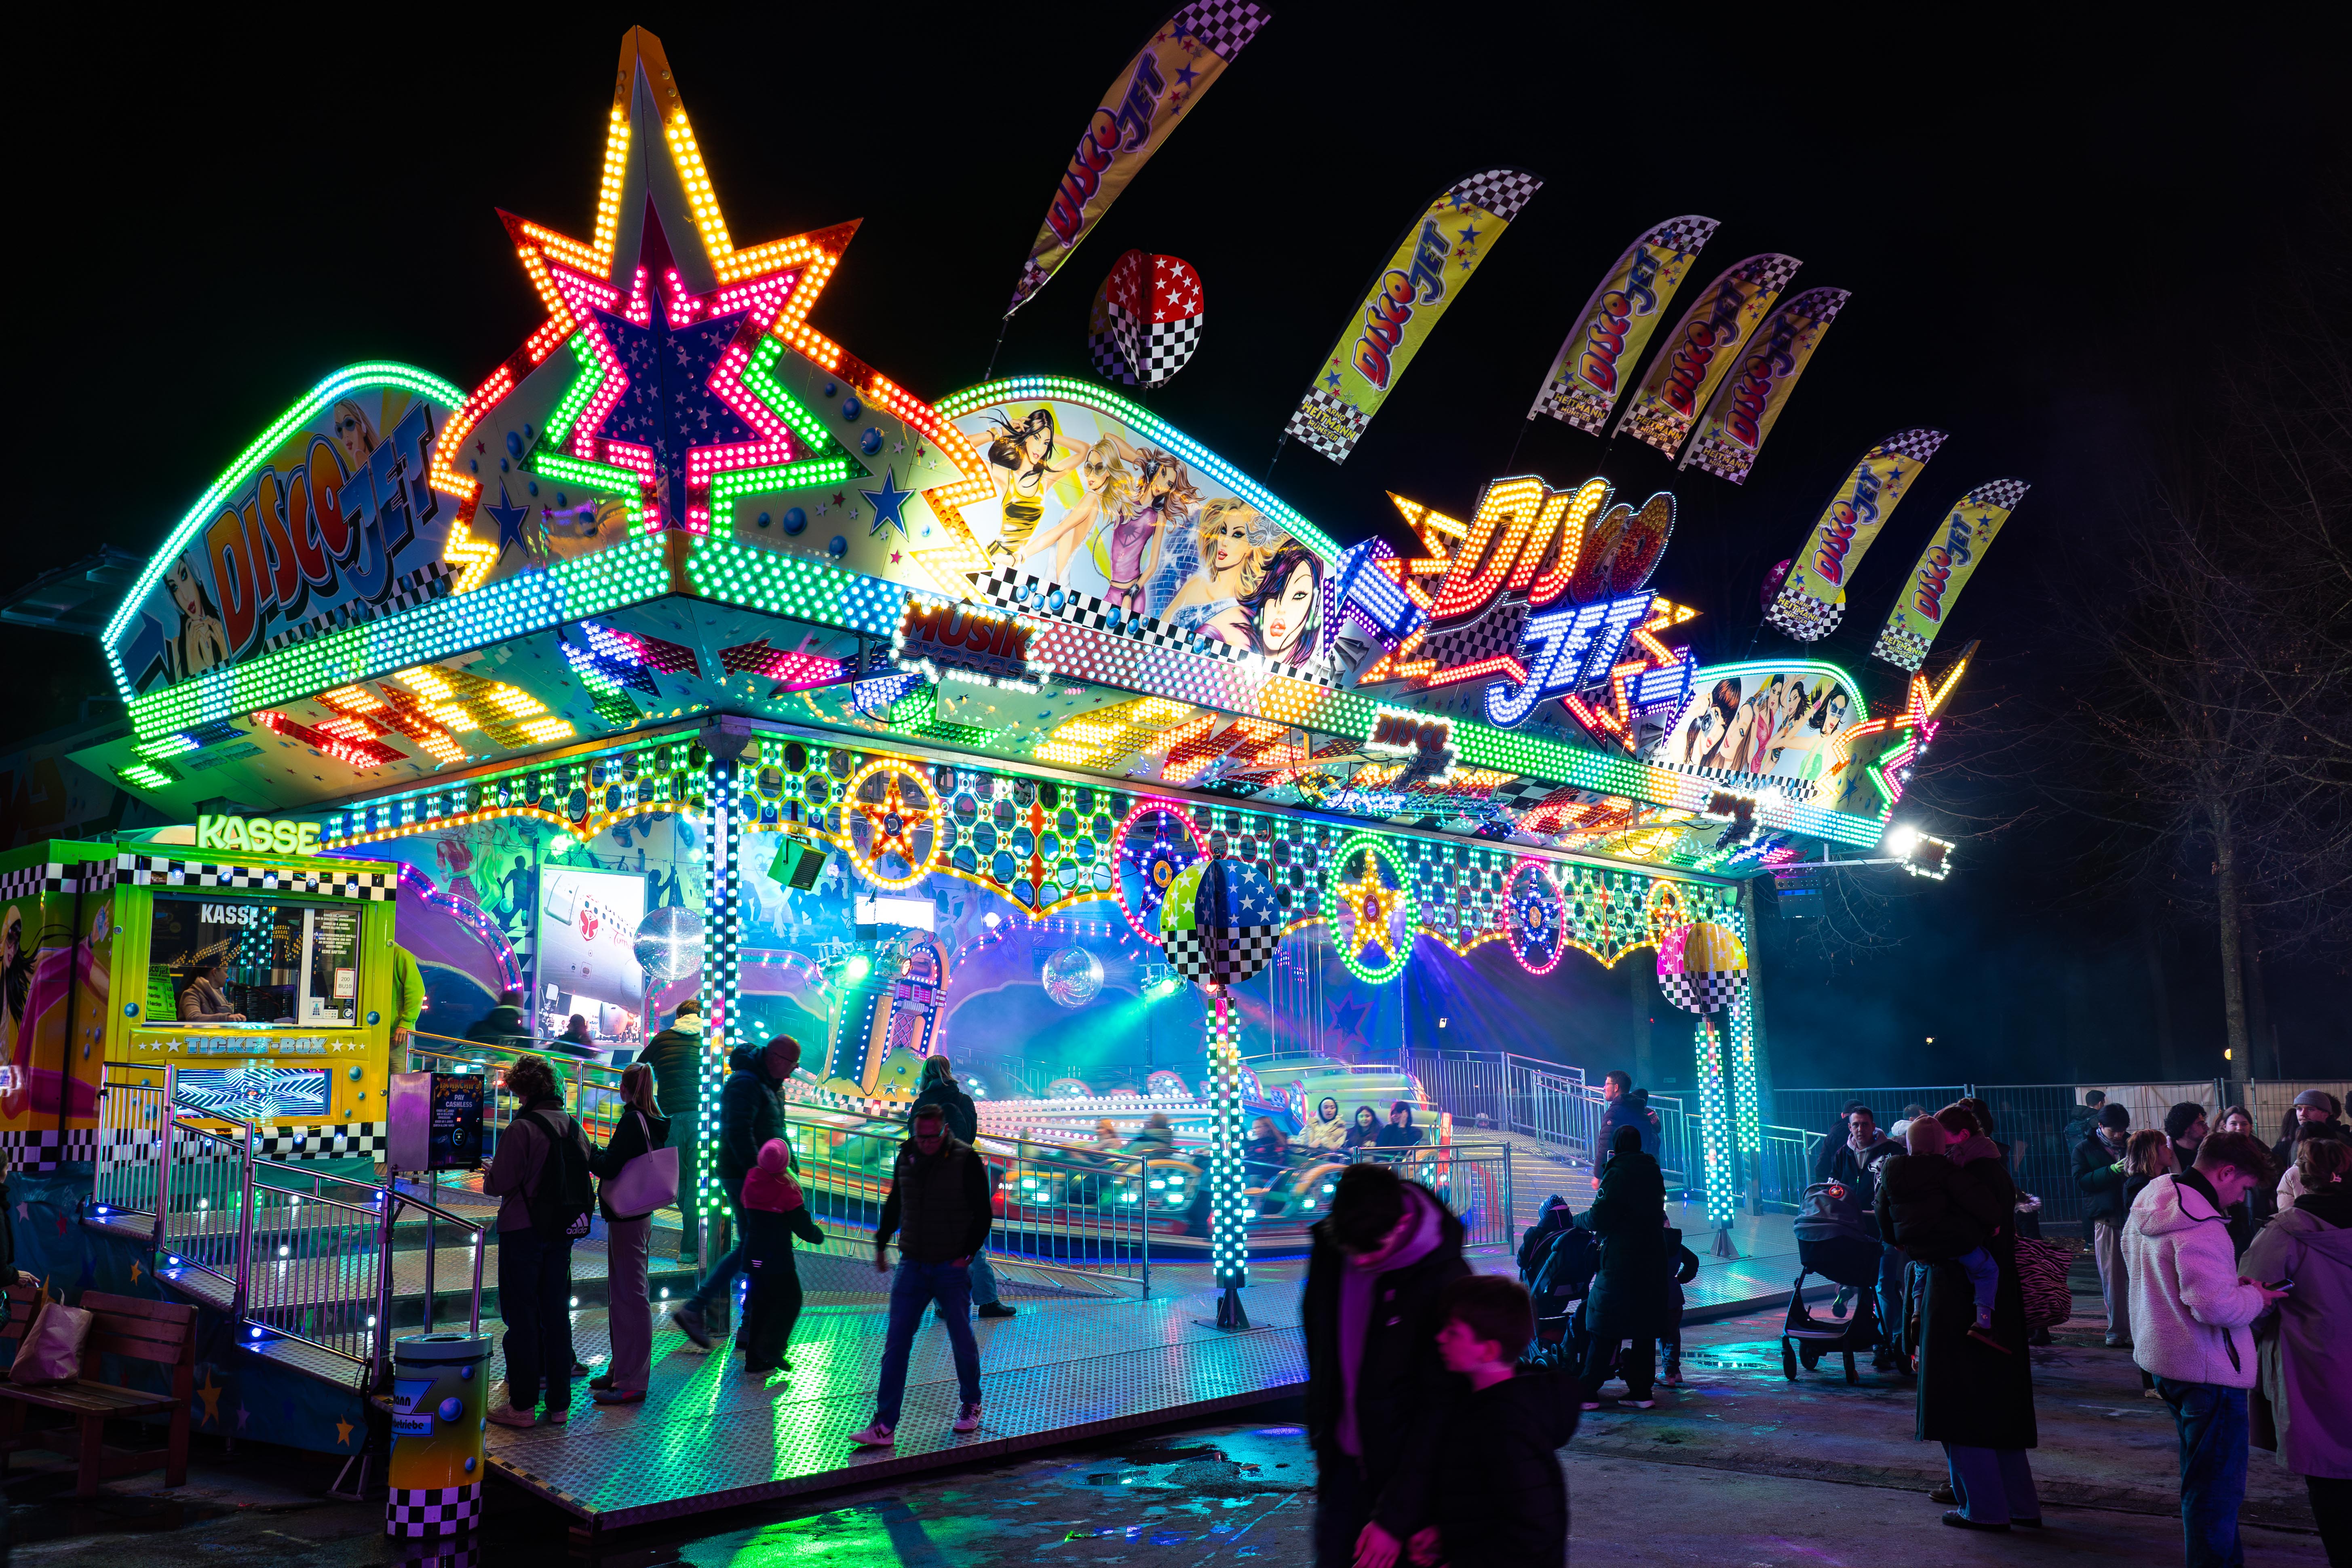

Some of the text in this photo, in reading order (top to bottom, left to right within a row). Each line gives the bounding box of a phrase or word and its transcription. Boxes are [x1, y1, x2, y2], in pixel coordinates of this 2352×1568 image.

[1046, 49, 1167, 246] DISCO JET
[1351, 217, 1452, 391] DISCO JET
[1578, 246, 1661, 397] DISCO JET
[1660, 279, 1746, 420] DISCO JET
[1725, 315, 1799, 450] DISCO JET
[1555, 393, 1605, 419] HEITMANN
[1575, 395, 1593, 404] ARNO
[1302, 401, 1357, 440] HEITMANN
[1326, 407, 1346, 421] ARNO
[1561, 407, 1590, 422] MÜNSTER
[1655, 416, 1671, 426] ARNO
[1308, 419, 1338, 441] MÜNSTER
[1636, 415, 1682, 440] HEITMANN
[1641, 426, 1667, 442] MÜNSTER
[1703, 447, 1748, 471] HEITMANN
[1721, 448, 1738, 457] ARNO
[1709, 459, 1734, 473] MÜNSTER
[204, 401, 436, 662] DISCO JET
[1811, 462, 1883, 587] DISCO JET
[1424, 475, 1676, 635] DISCO
[1911, 511, 1973, 624] DISCO JET
[1778, 597, 1820, 622] HEITMANN
[1783, 610, 1808, 625] MÜNSTER
[1796, 600, 1811, 610] ARNO
[901, 599, 1036, 662] MUSIK
[1899, 636, 1914, 645] ARNO
[1882, 634, 1924, 656] HEITMANN
[1888, 646, 1912, 659] MÜNSTER
[1486, 590, 1656, 728] JET
[1371, 713, 1449, 752] DISCO
[1709, 790, 1756, 821] DISCO
[197, 814, 321, 855] KASSE
[201, 904, 259, 925] KASSE
[184, 1036, 328, 1055] TICKET-BOX
